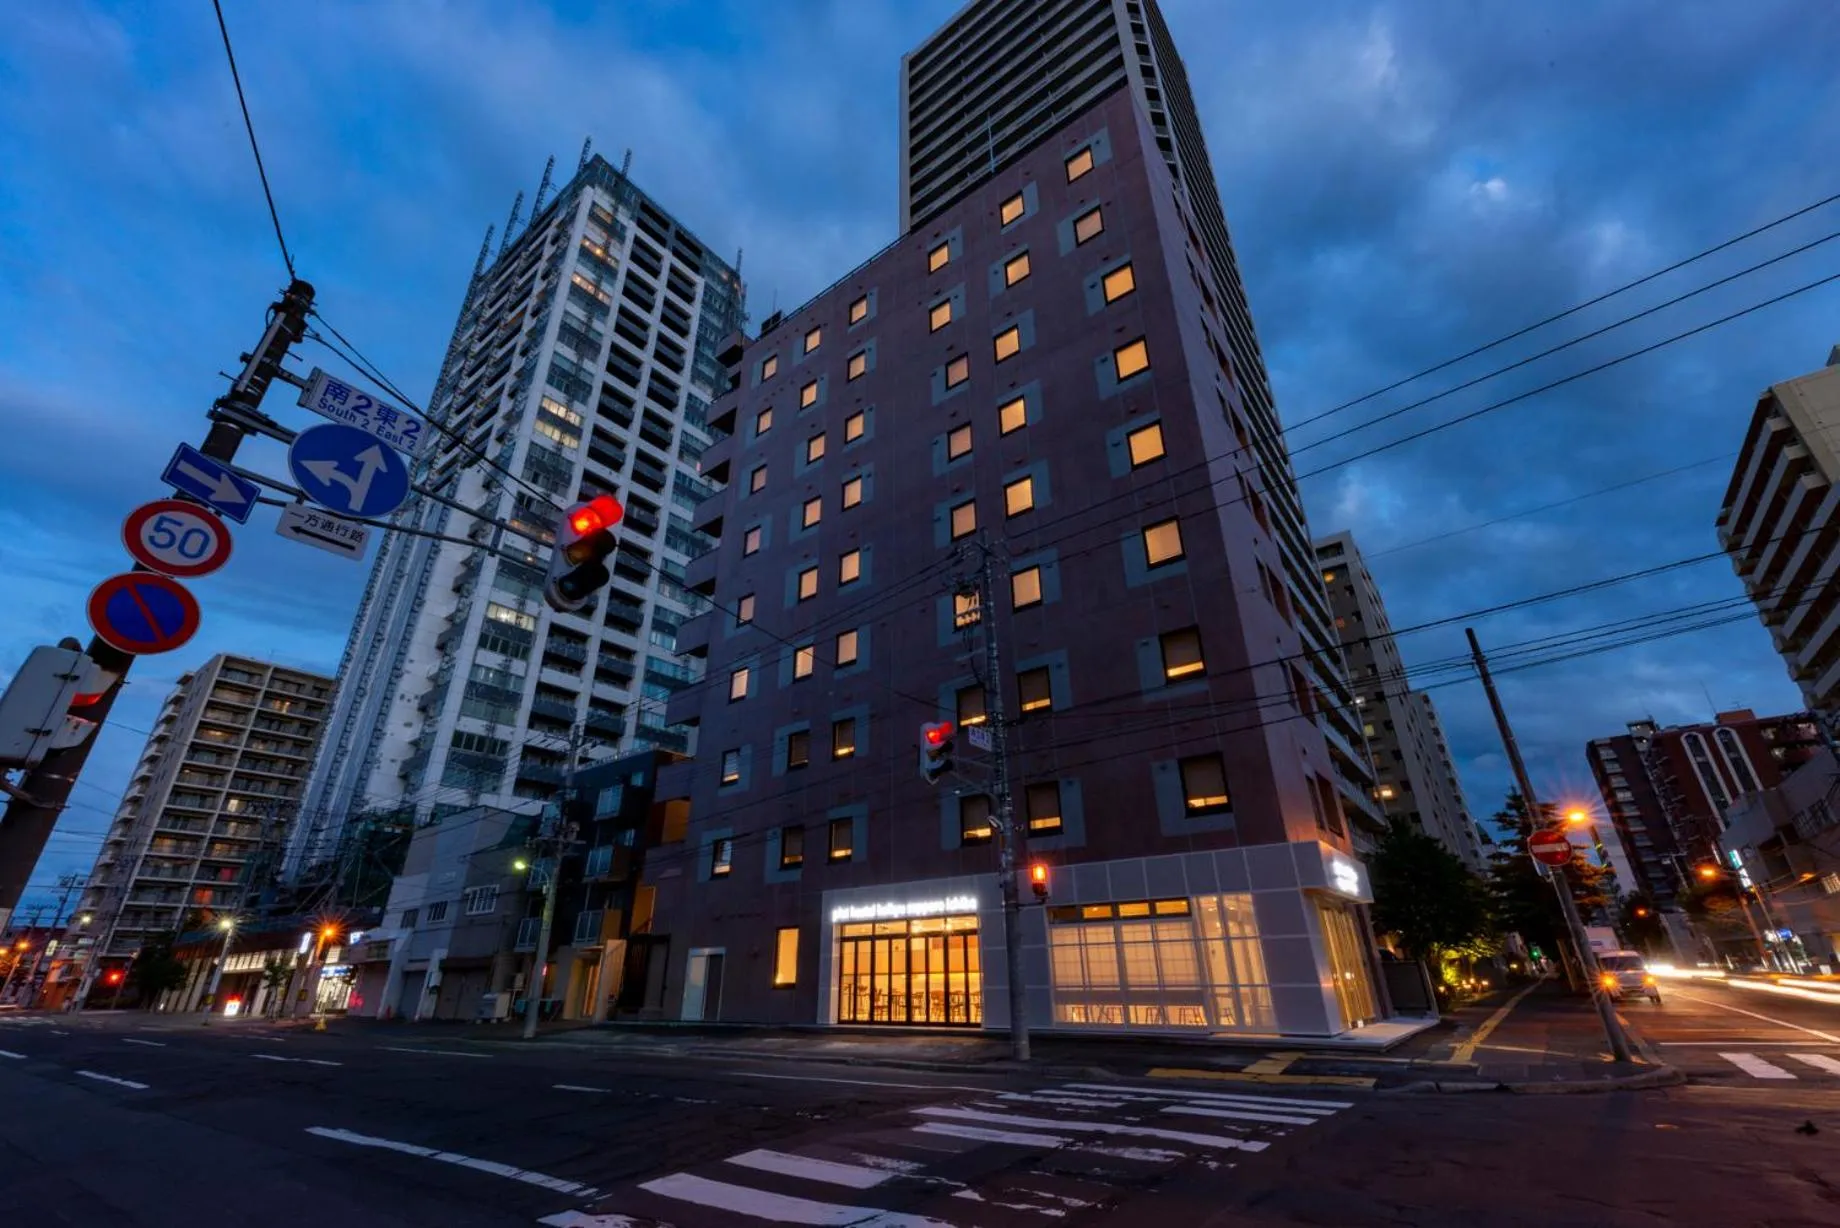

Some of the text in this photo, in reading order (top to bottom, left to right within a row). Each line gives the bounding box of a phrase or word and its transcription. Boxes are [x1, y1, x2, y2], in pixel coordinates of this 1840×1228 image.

[318, 397, 416, 450] South 2 East 2
[323, 380, 420, 440] 南2東2
[148, 515, 210, 559] 50
[288, 511, 364, 543] 一方通行路
